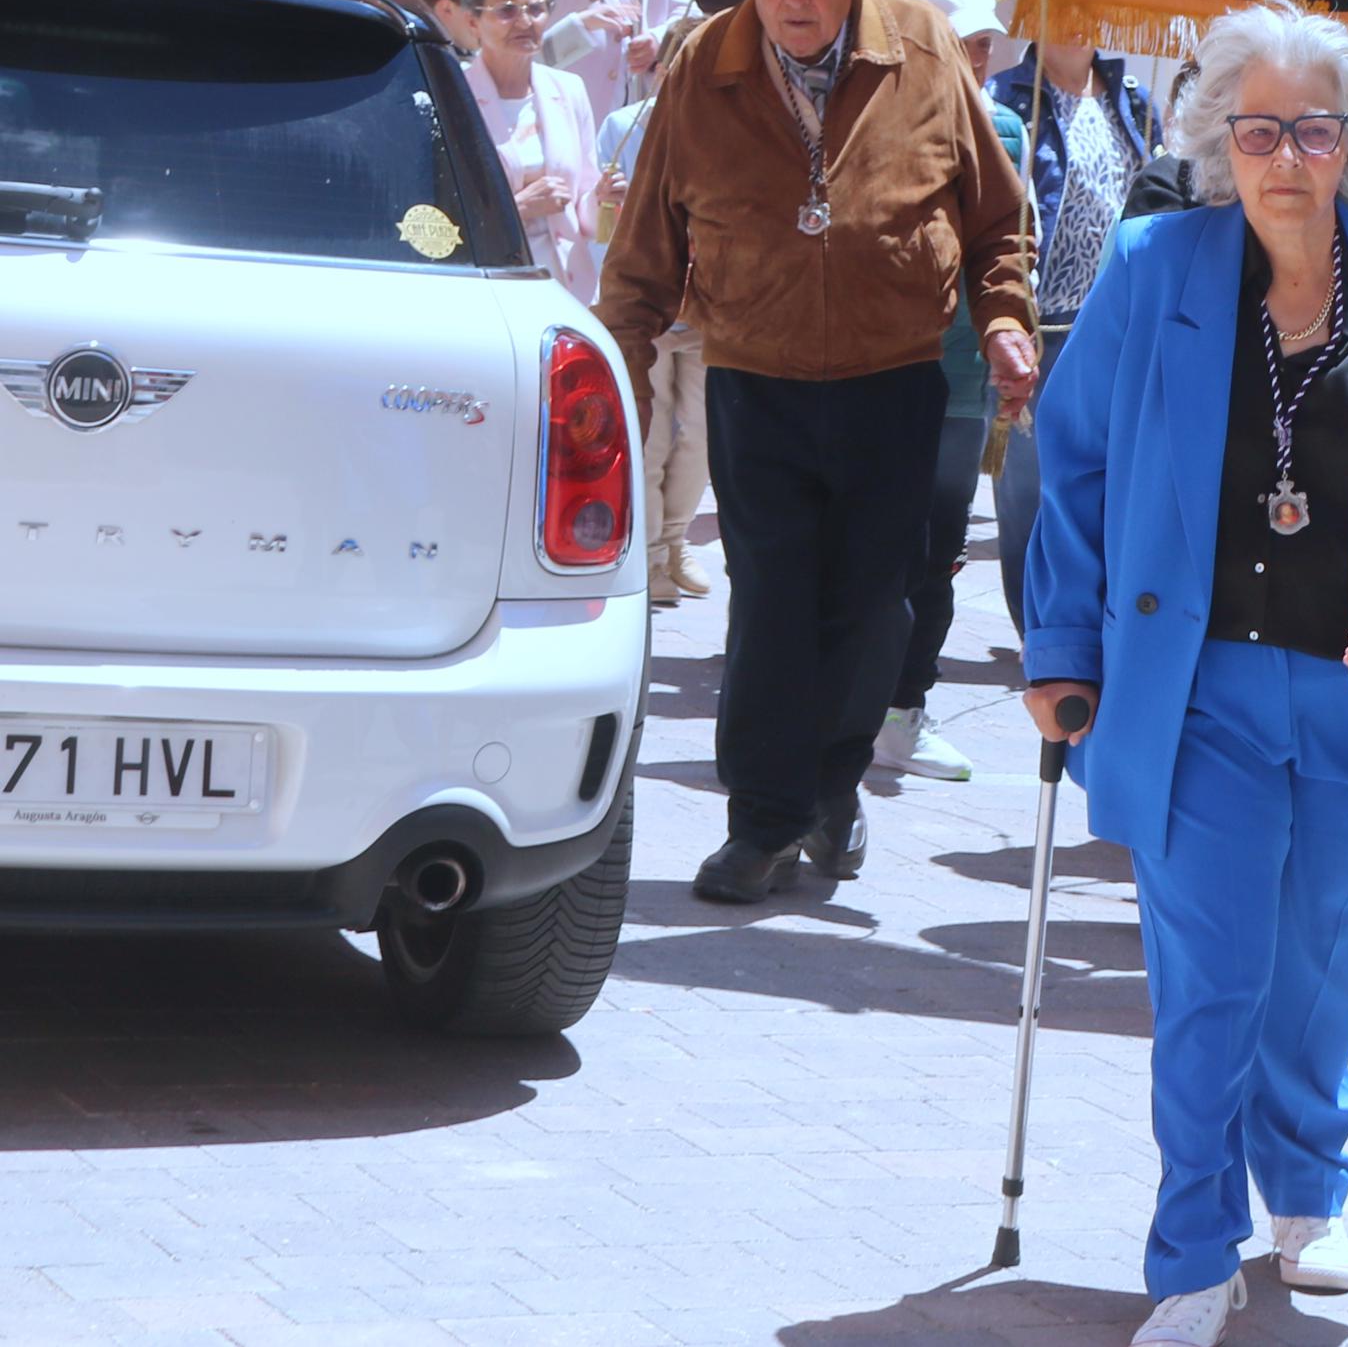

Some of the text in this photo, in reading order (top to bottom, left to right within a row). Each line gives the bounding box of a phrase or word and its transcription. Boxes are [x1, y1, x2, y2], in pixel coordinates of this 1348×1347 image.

[55, 375, 122, 402] MINI
[2, 734, 236, 798] 71 HVL
[13, 809, 107, 824] Augusta Aragón
